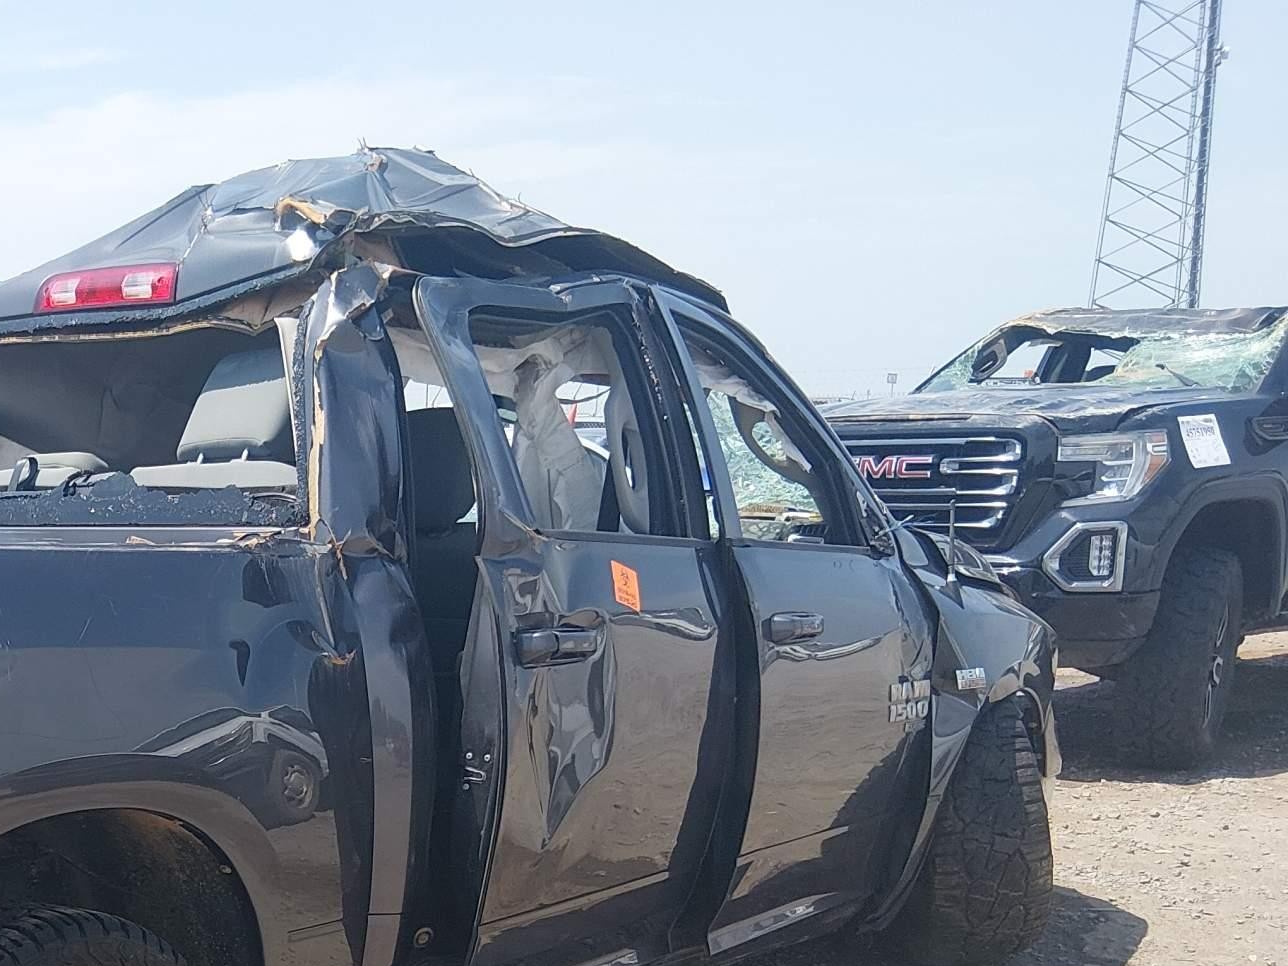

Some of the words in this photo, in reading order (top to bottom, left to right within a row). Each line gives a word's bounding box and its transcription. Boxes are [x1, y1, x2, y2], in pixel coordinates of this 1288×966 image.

[853, 455, 934, 479] MC
[890, 680, 931, 702] RAM
[889, 700, 928, 722] 1500
